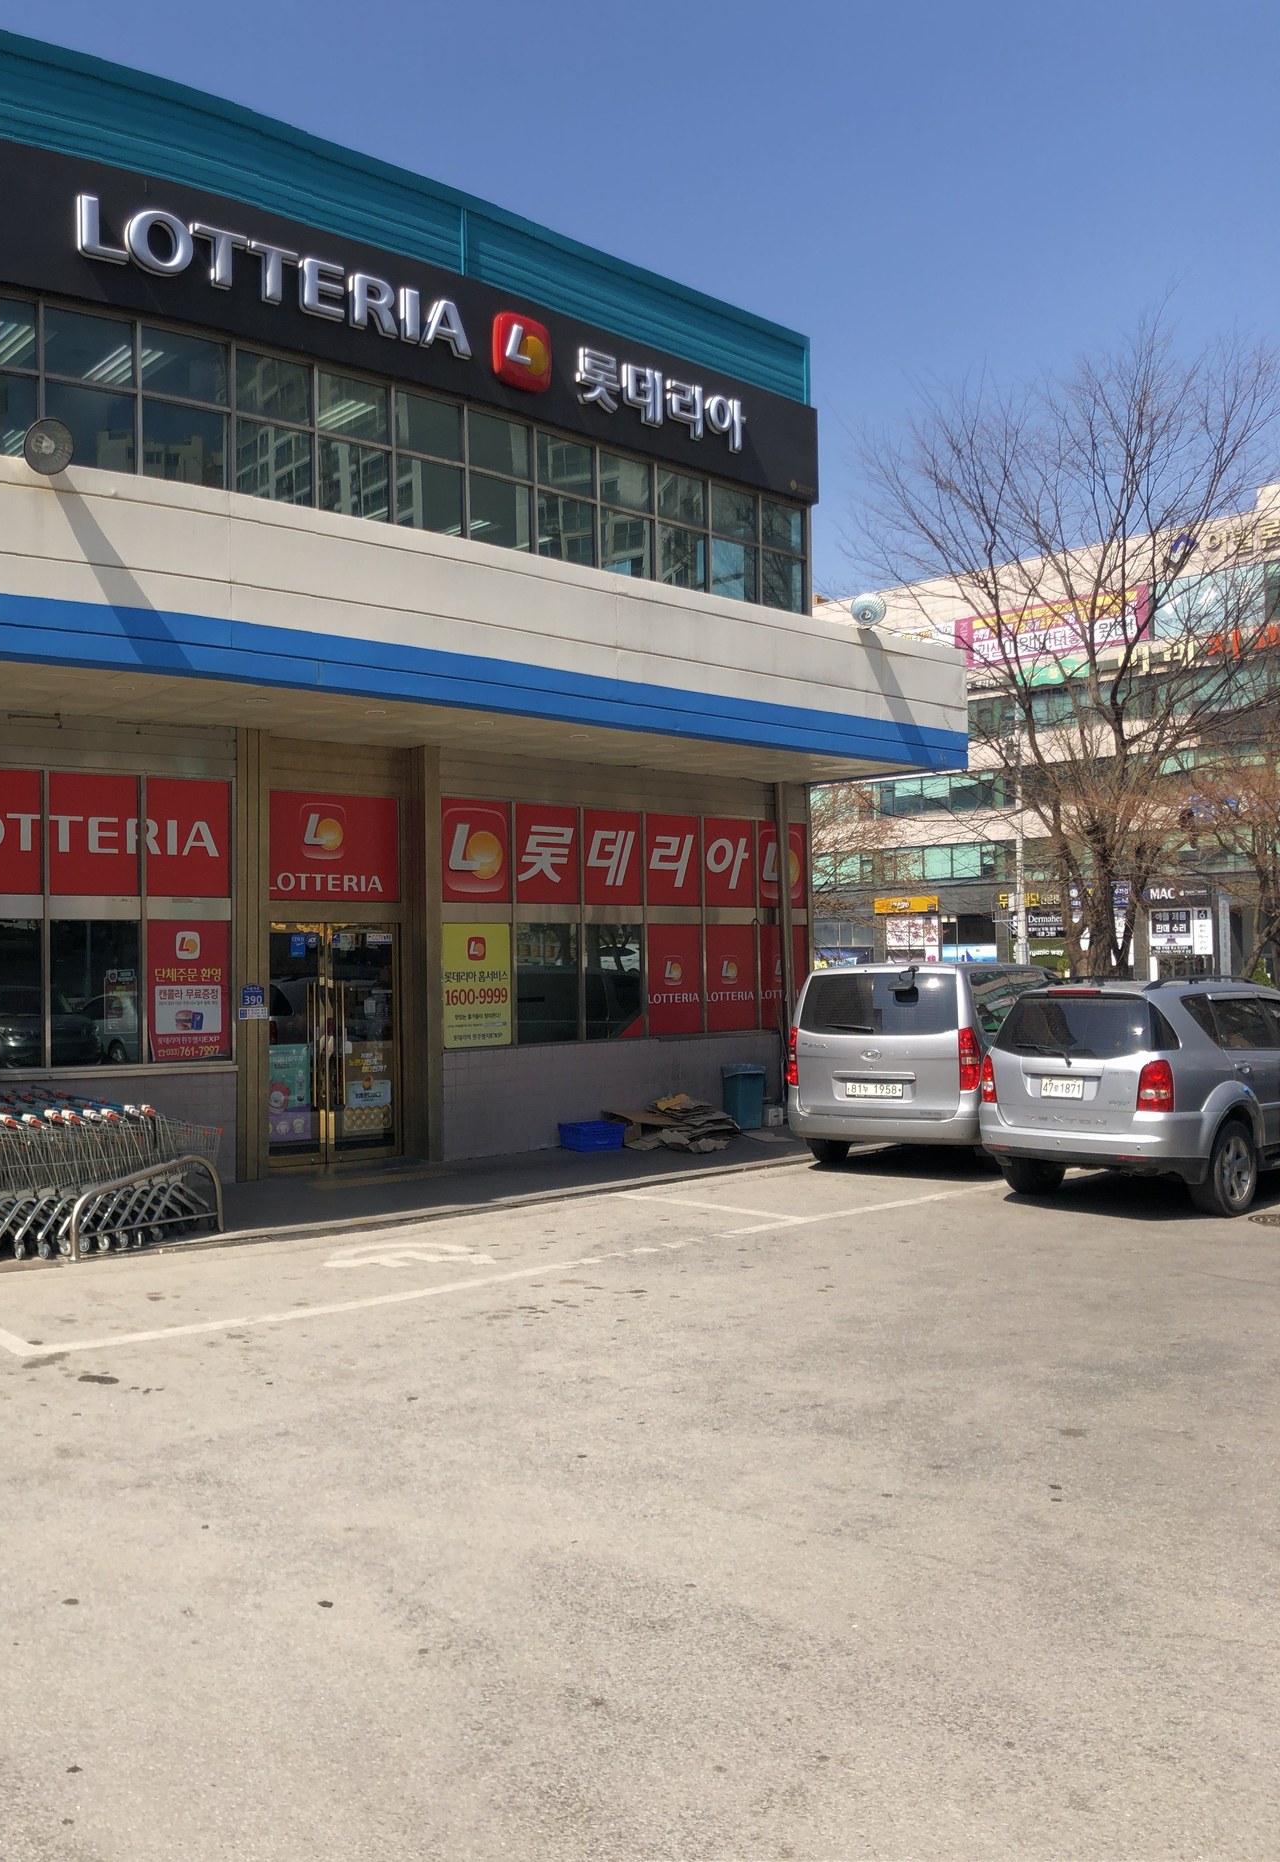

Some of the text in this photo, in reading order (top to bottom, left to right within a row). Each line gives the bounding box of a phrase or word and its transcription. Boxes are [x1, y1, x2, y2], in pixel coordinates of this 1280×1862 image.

[76, 194, 472, 360] LOTTERIA
[576, 345, 746, 453] 롯데리아
[518, 824, 750, 890] 롯데리아
[270, 872, 384, 893] OTTERIA
[1150, 888, 1176, 900] MAC
[1155, 923, 1187, 933] 판매 수리
[1051, 949, 1064, 957] way
[154, 968, 222, 982] 단체주문 환영
[444, 971, 509, 984] 롯데리아 홈서비스
[158, 988, 219, 1000] 캔콜라 무료증정
[243, 995, 264, 1005] 390
[445, 987, 509, 1006] 1600-9999
[648, 992, 700, 1004] LOTTERIA
[706, 991, 755, 1002] LOTTERIA
[157, 1037, 181, 1045] 롯데리아
[873, 1083, 898, 1095] 1958
[1060, 1080, 1082, 1095] 1871
